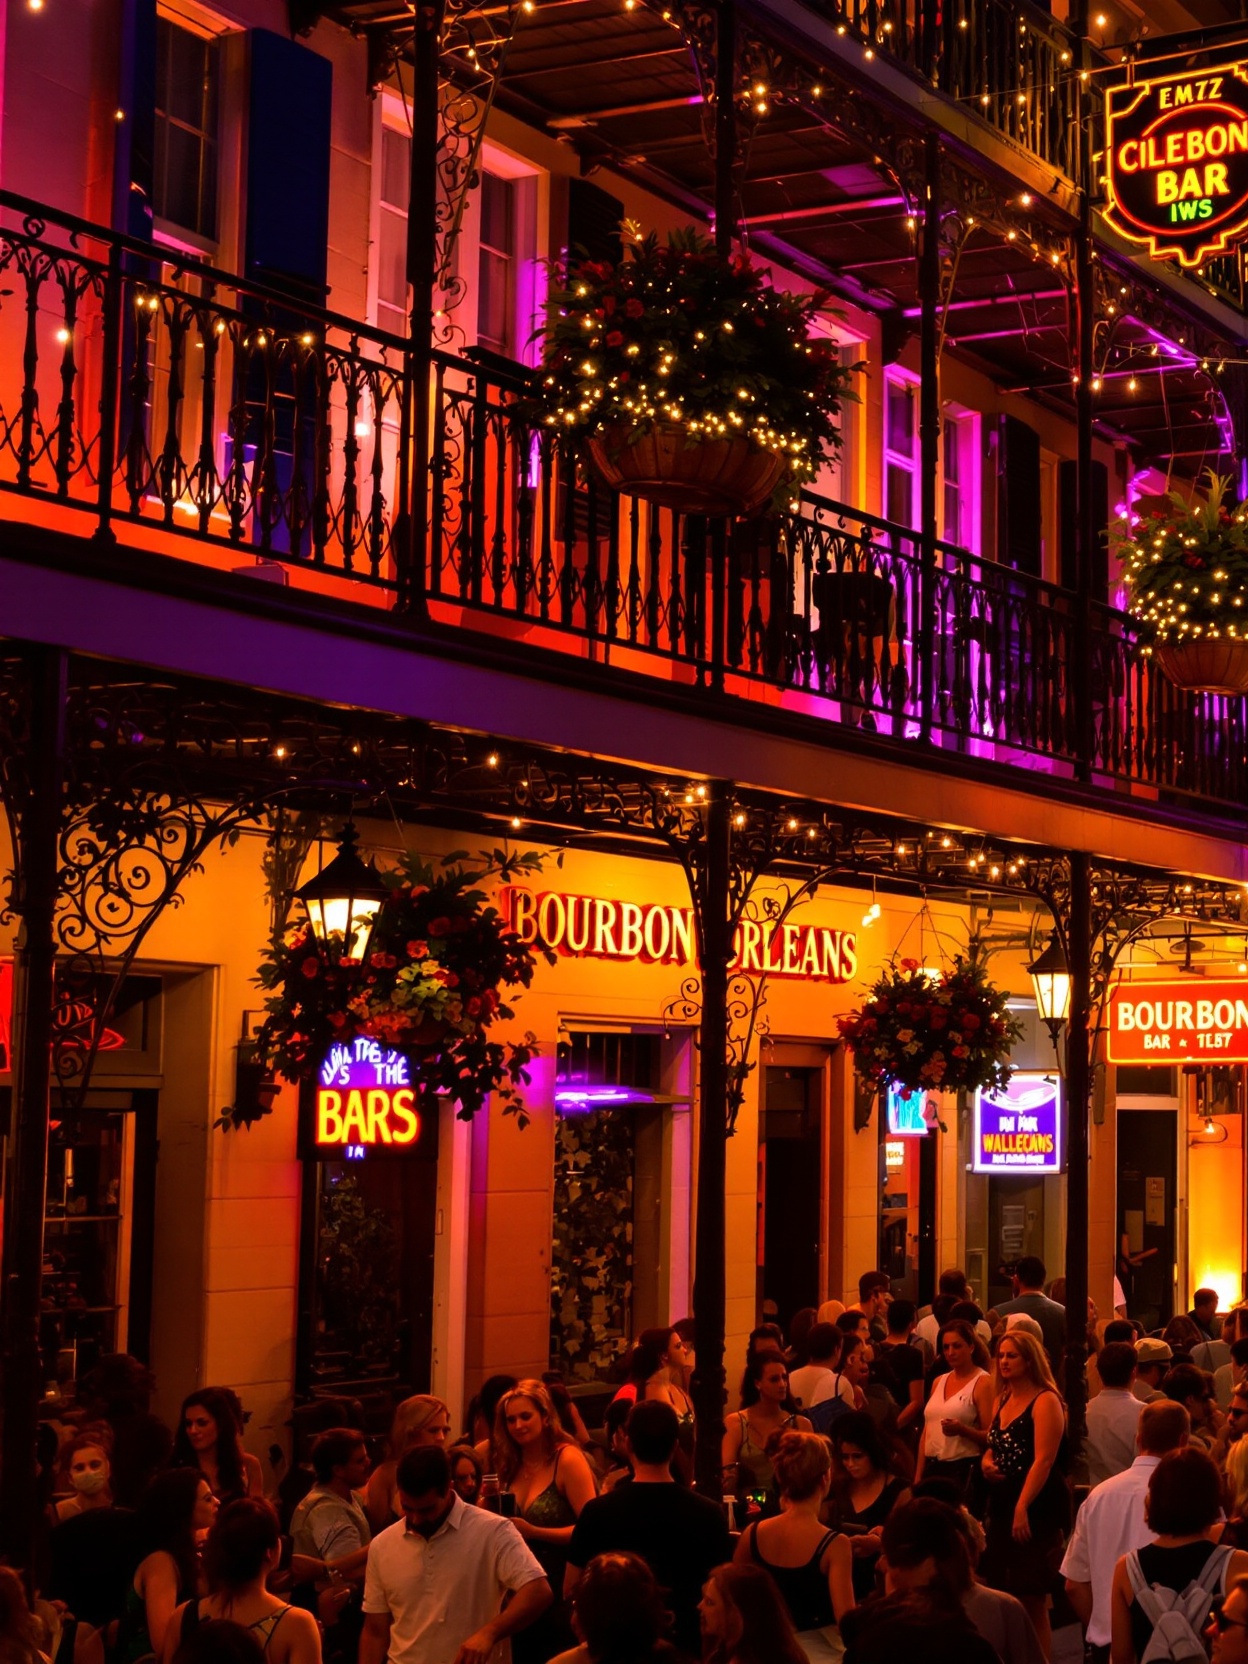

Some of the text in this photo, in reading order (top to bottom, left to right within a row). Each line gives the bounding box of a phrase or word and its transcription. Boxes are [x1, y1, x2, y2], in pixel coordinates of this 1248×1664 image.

[1157, 163, 1230, 204] BAR
[504, 887, 695, 963] BOURBON
[1143, 1033, 1171, 1049] BAR
[318, 1089, 419, 1144] BARS
